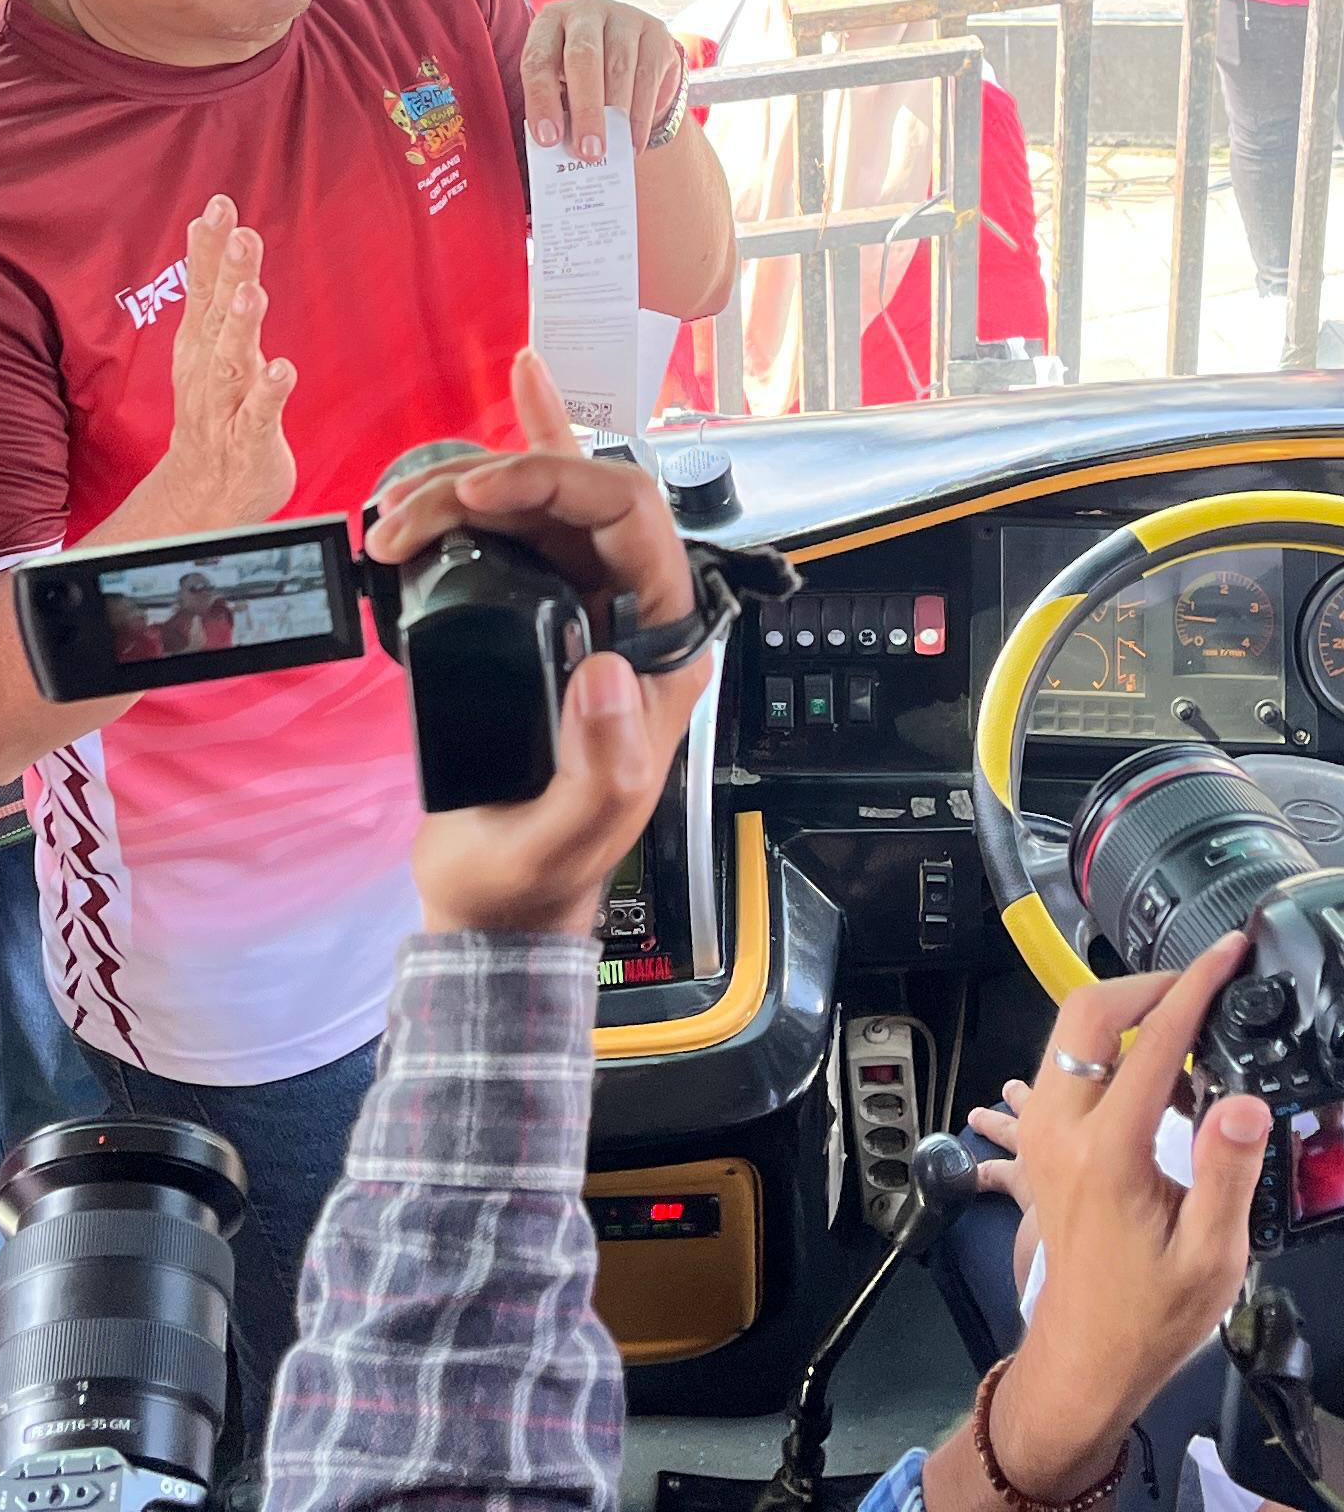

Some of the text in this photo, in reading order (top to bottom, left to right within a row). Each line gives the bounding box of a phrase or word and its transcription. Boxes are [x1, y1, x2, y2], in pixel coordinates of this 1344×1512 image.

[1219, 583, 1229, 595] 2
[1249, 602, 1259, 614] 3
[624, 954, 674, 983] NAKAL
[109, 1418, 131, 1431] GM
